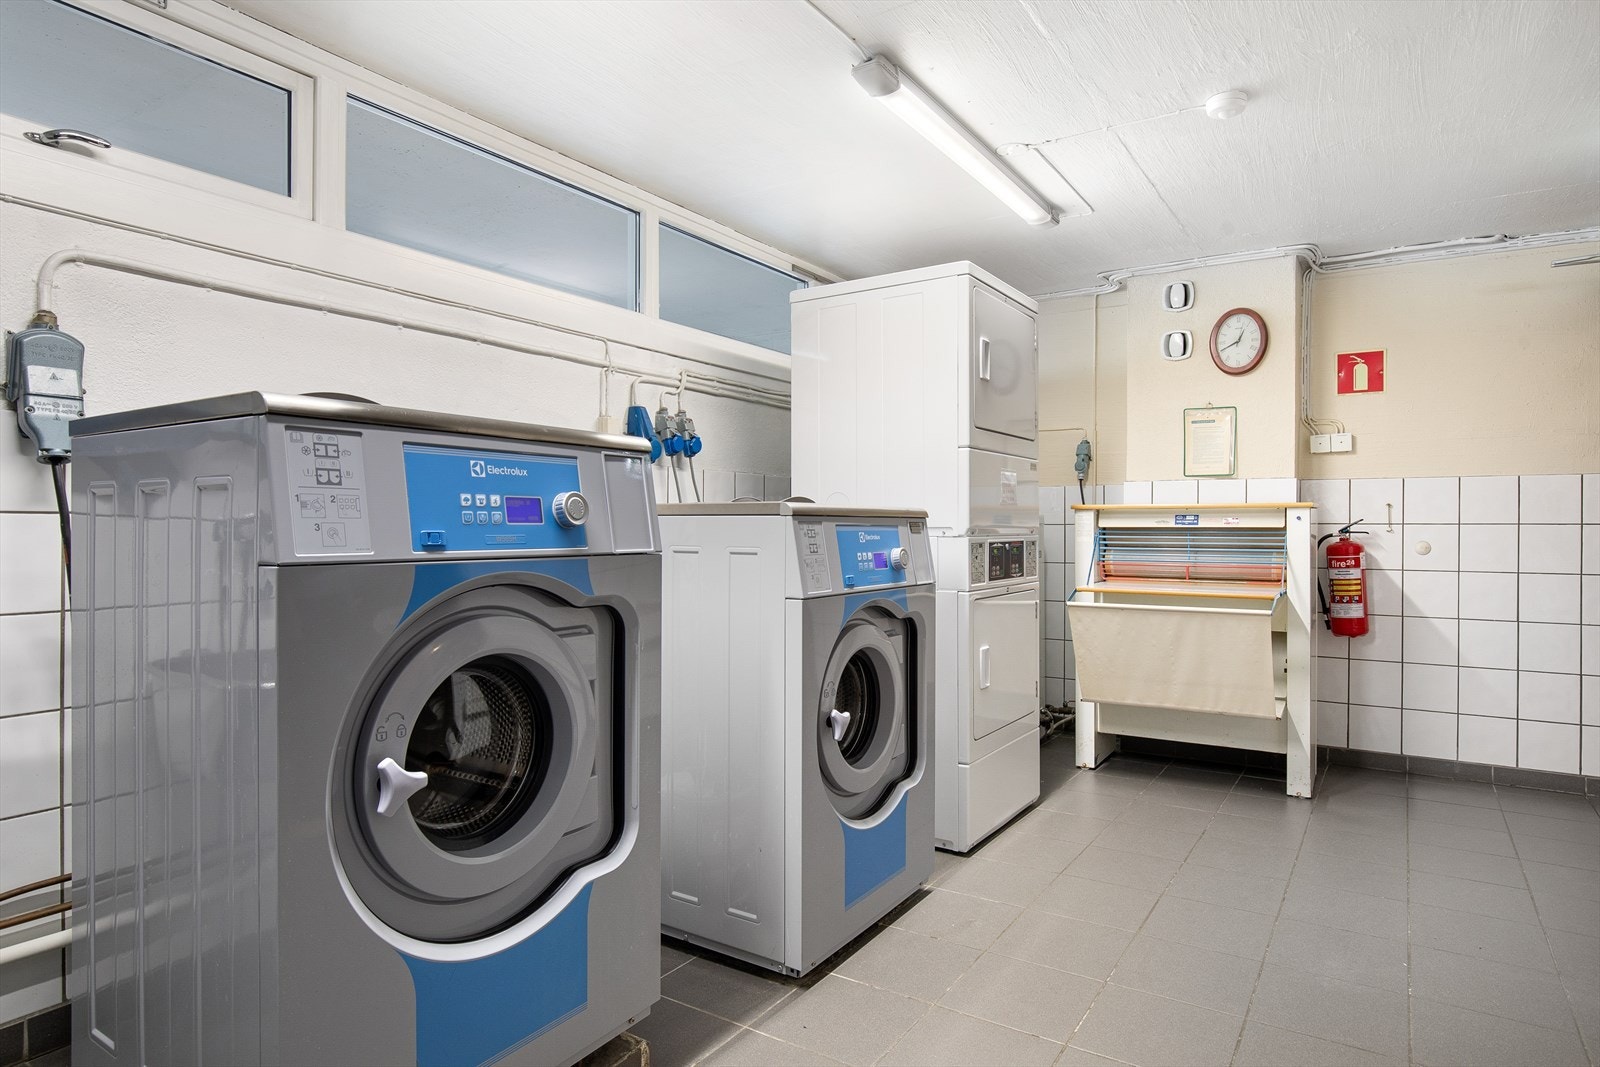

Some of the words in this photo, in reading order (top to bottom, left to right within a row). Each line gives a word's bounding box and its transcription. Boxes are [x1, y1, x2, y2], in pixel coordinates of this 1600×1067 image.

[487, 465, 528, 476] Electrolux
[294, 494, 299, 502] 1
[330, 495, 336, 503] 2
[314, 523, 320, 532] 3
[1331, 559, 1355, 568] fire24
